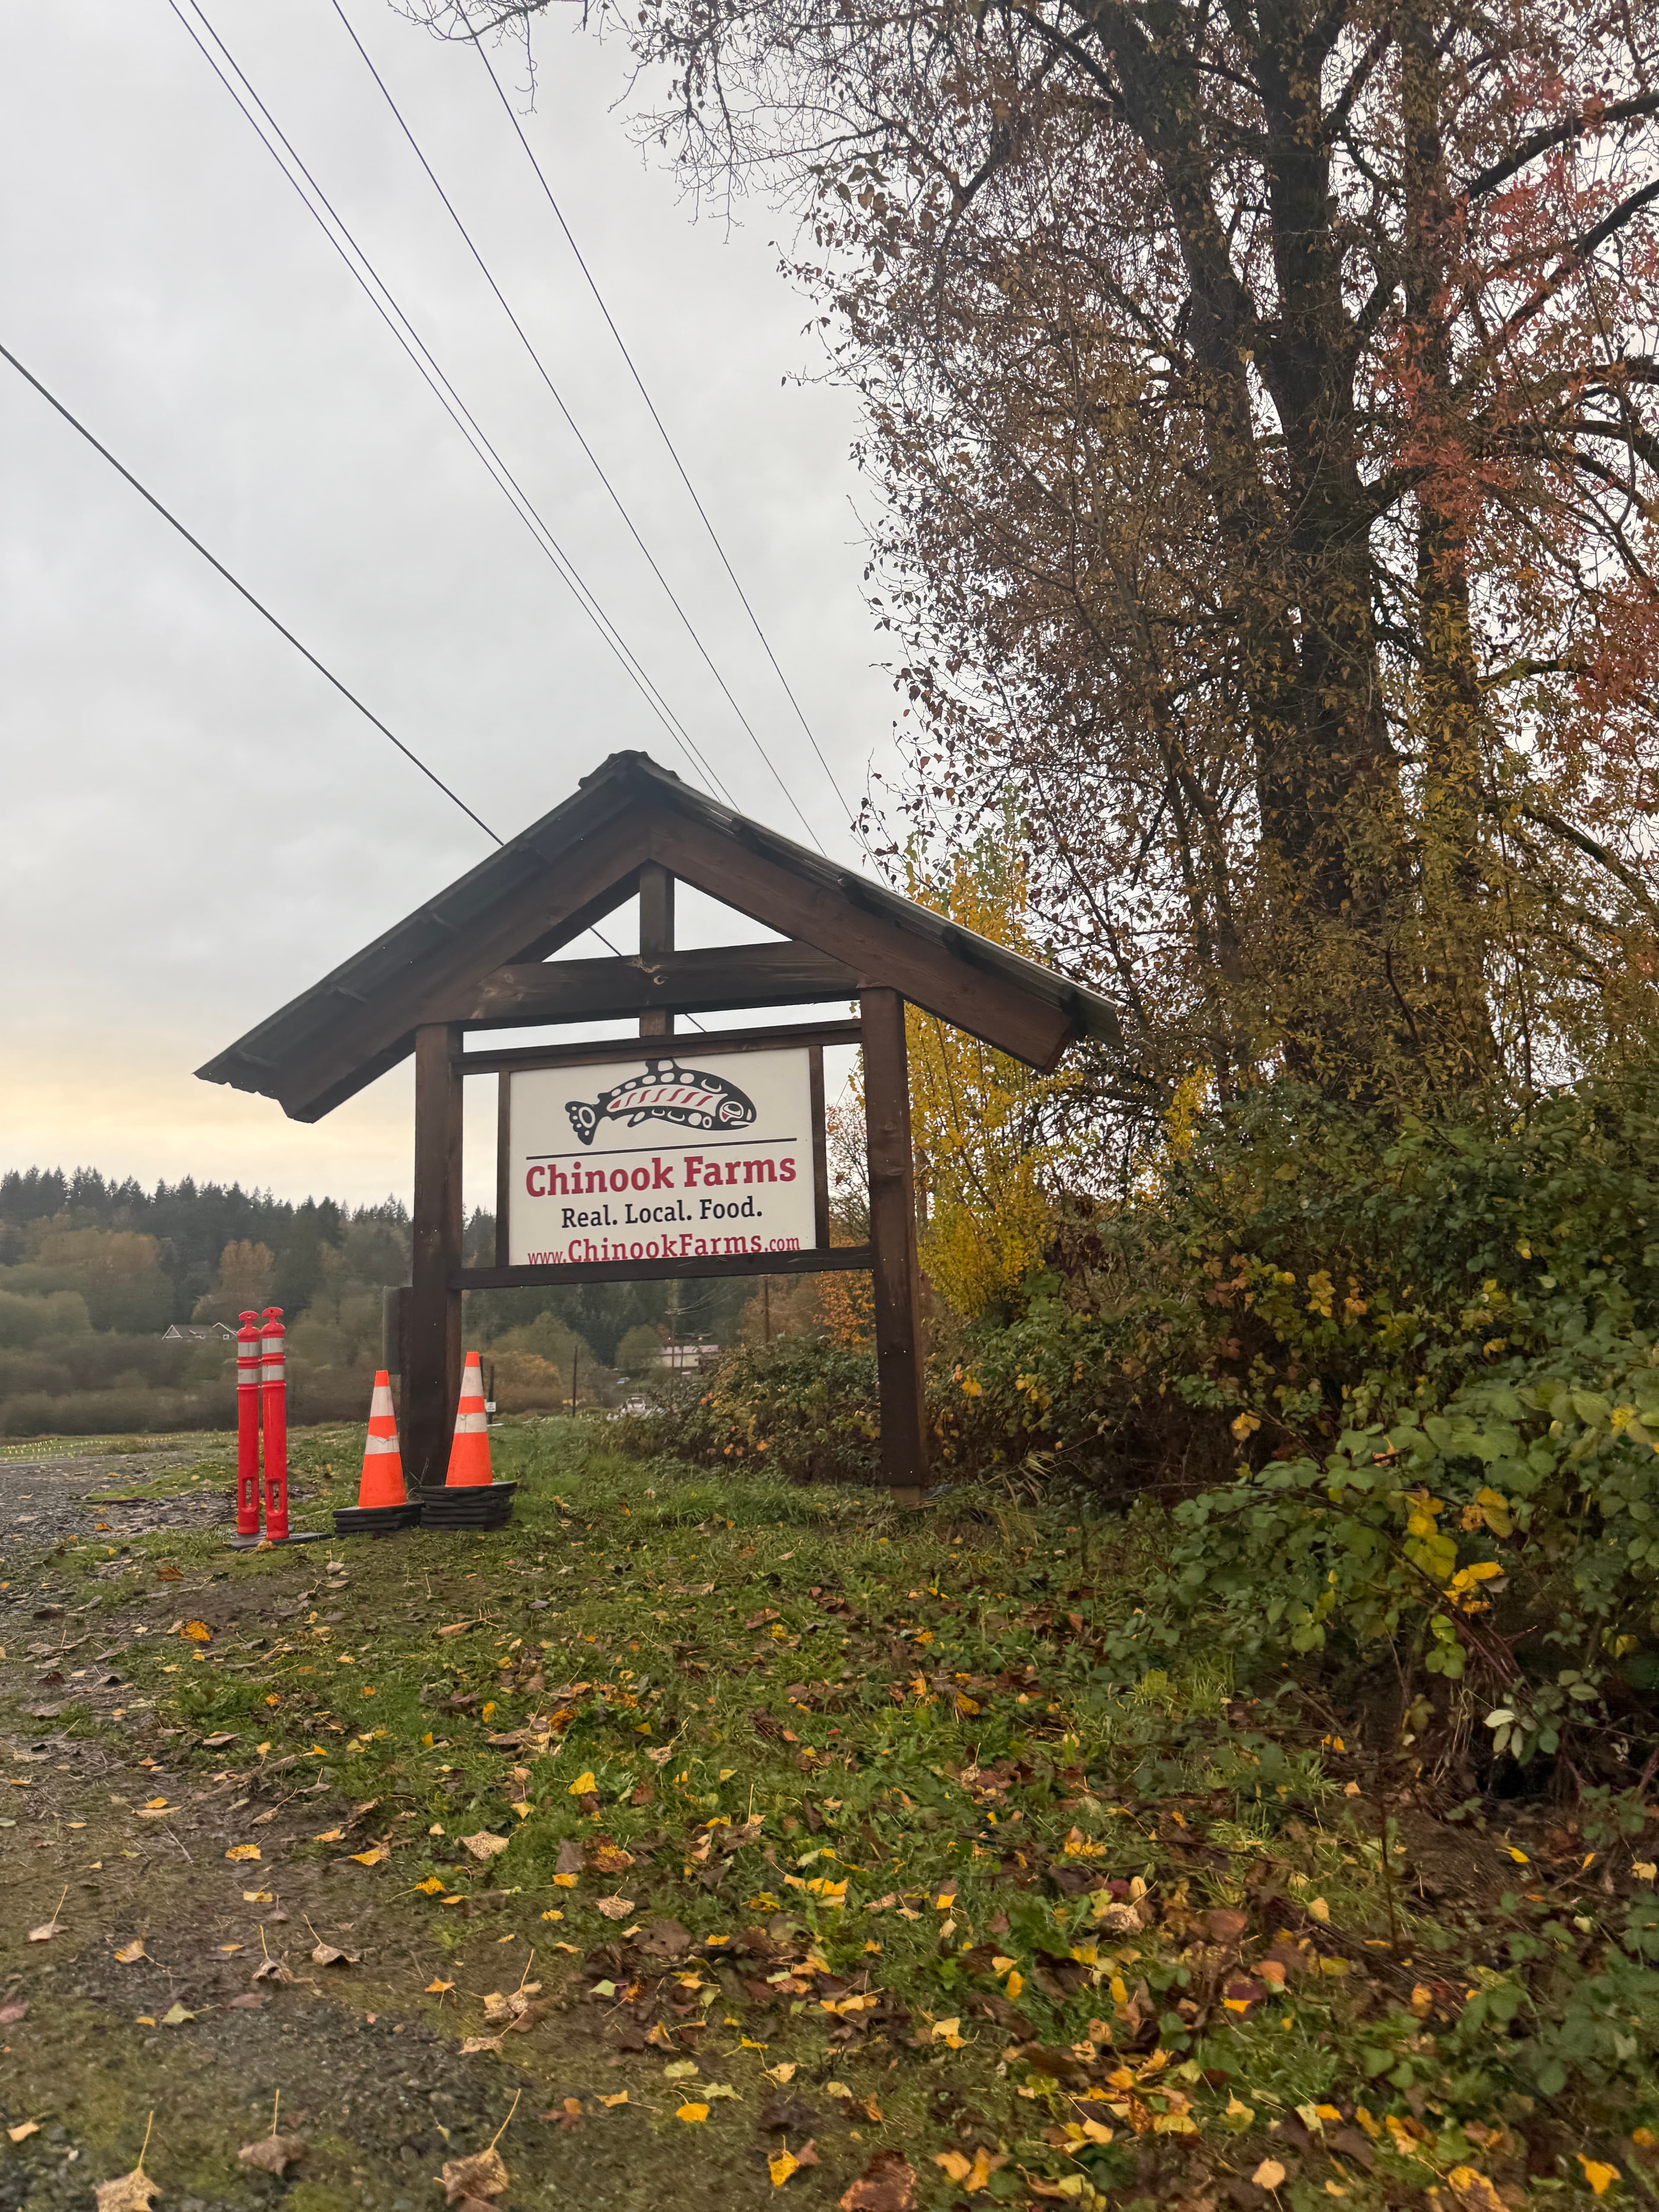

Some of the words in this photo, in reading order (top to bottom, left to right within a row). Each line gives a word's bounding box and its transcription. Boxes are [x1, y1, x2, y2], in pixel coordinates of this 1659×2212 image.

[526, 1157, 674, 1197] Chinook
[684, 1156, 796, 1187] Farms
[562, 1204, 618, 1228] Real.
[625, 1199, 692, 1224] Local.
[699, 1195, 763, 1220] Food.
[528, 1233, 800, 1265] www.ChinookFarms.com
